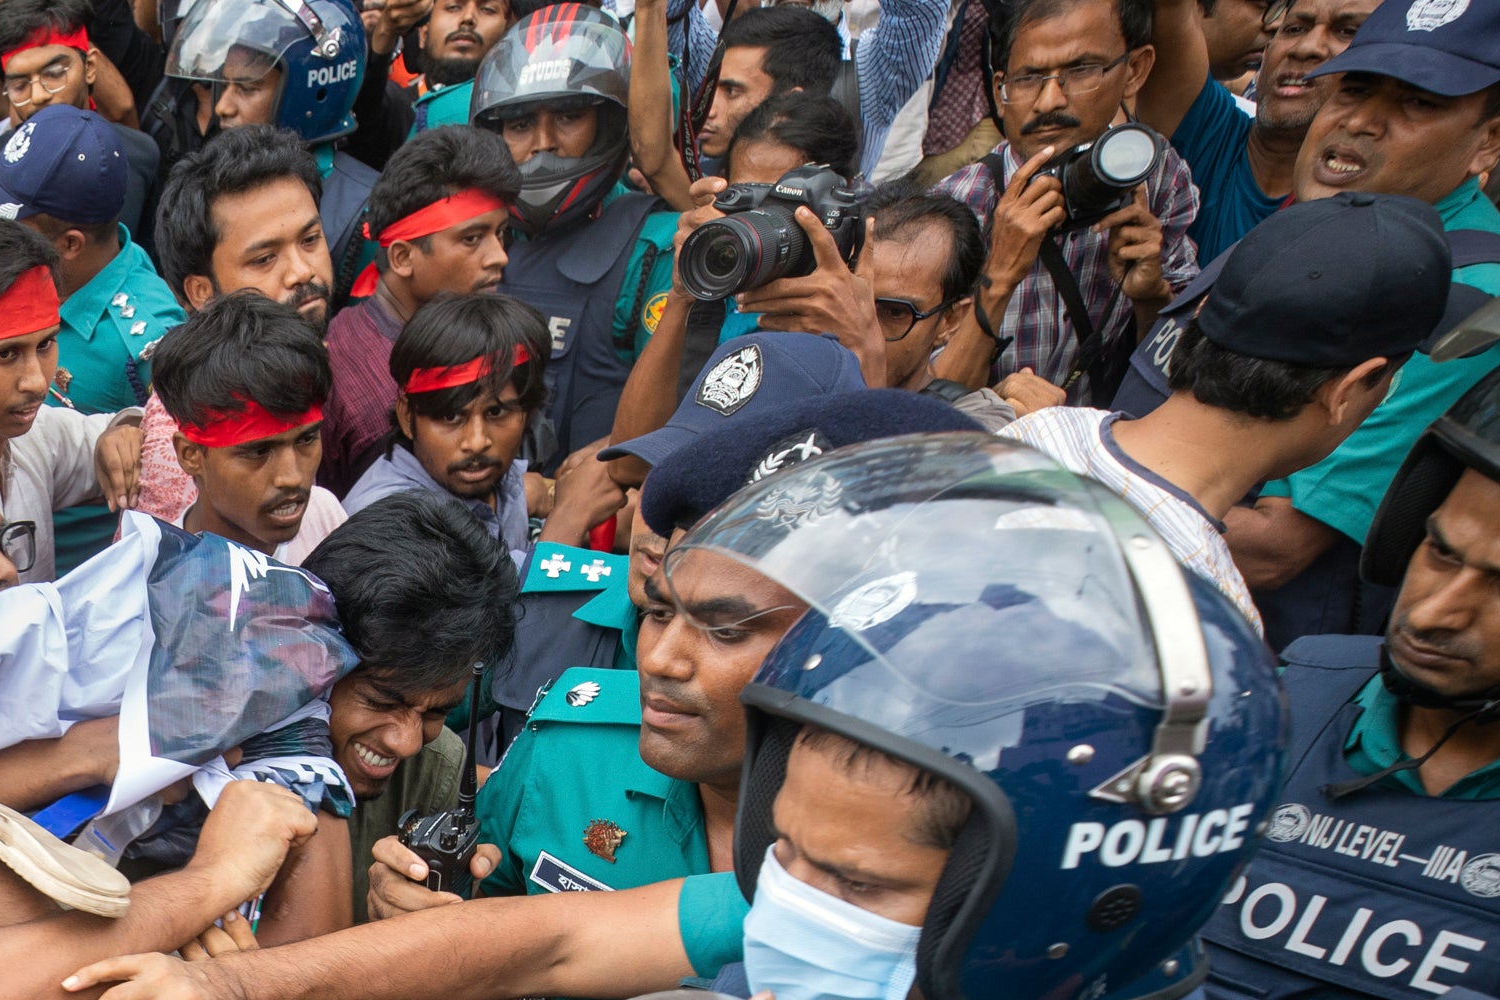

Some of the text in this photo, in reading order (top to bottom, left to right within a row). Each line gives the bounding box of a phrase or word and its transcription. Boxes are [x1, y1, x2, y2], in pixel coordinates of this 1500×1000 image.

[307, 60, 357, 88] POLICE
[519, 59, 571, 85] STUDDS
[775, 184, 803, 196] Canon
[1060, 803, 1254, 869] POLICE
[1300, 814, 1345, 849] NIJ
